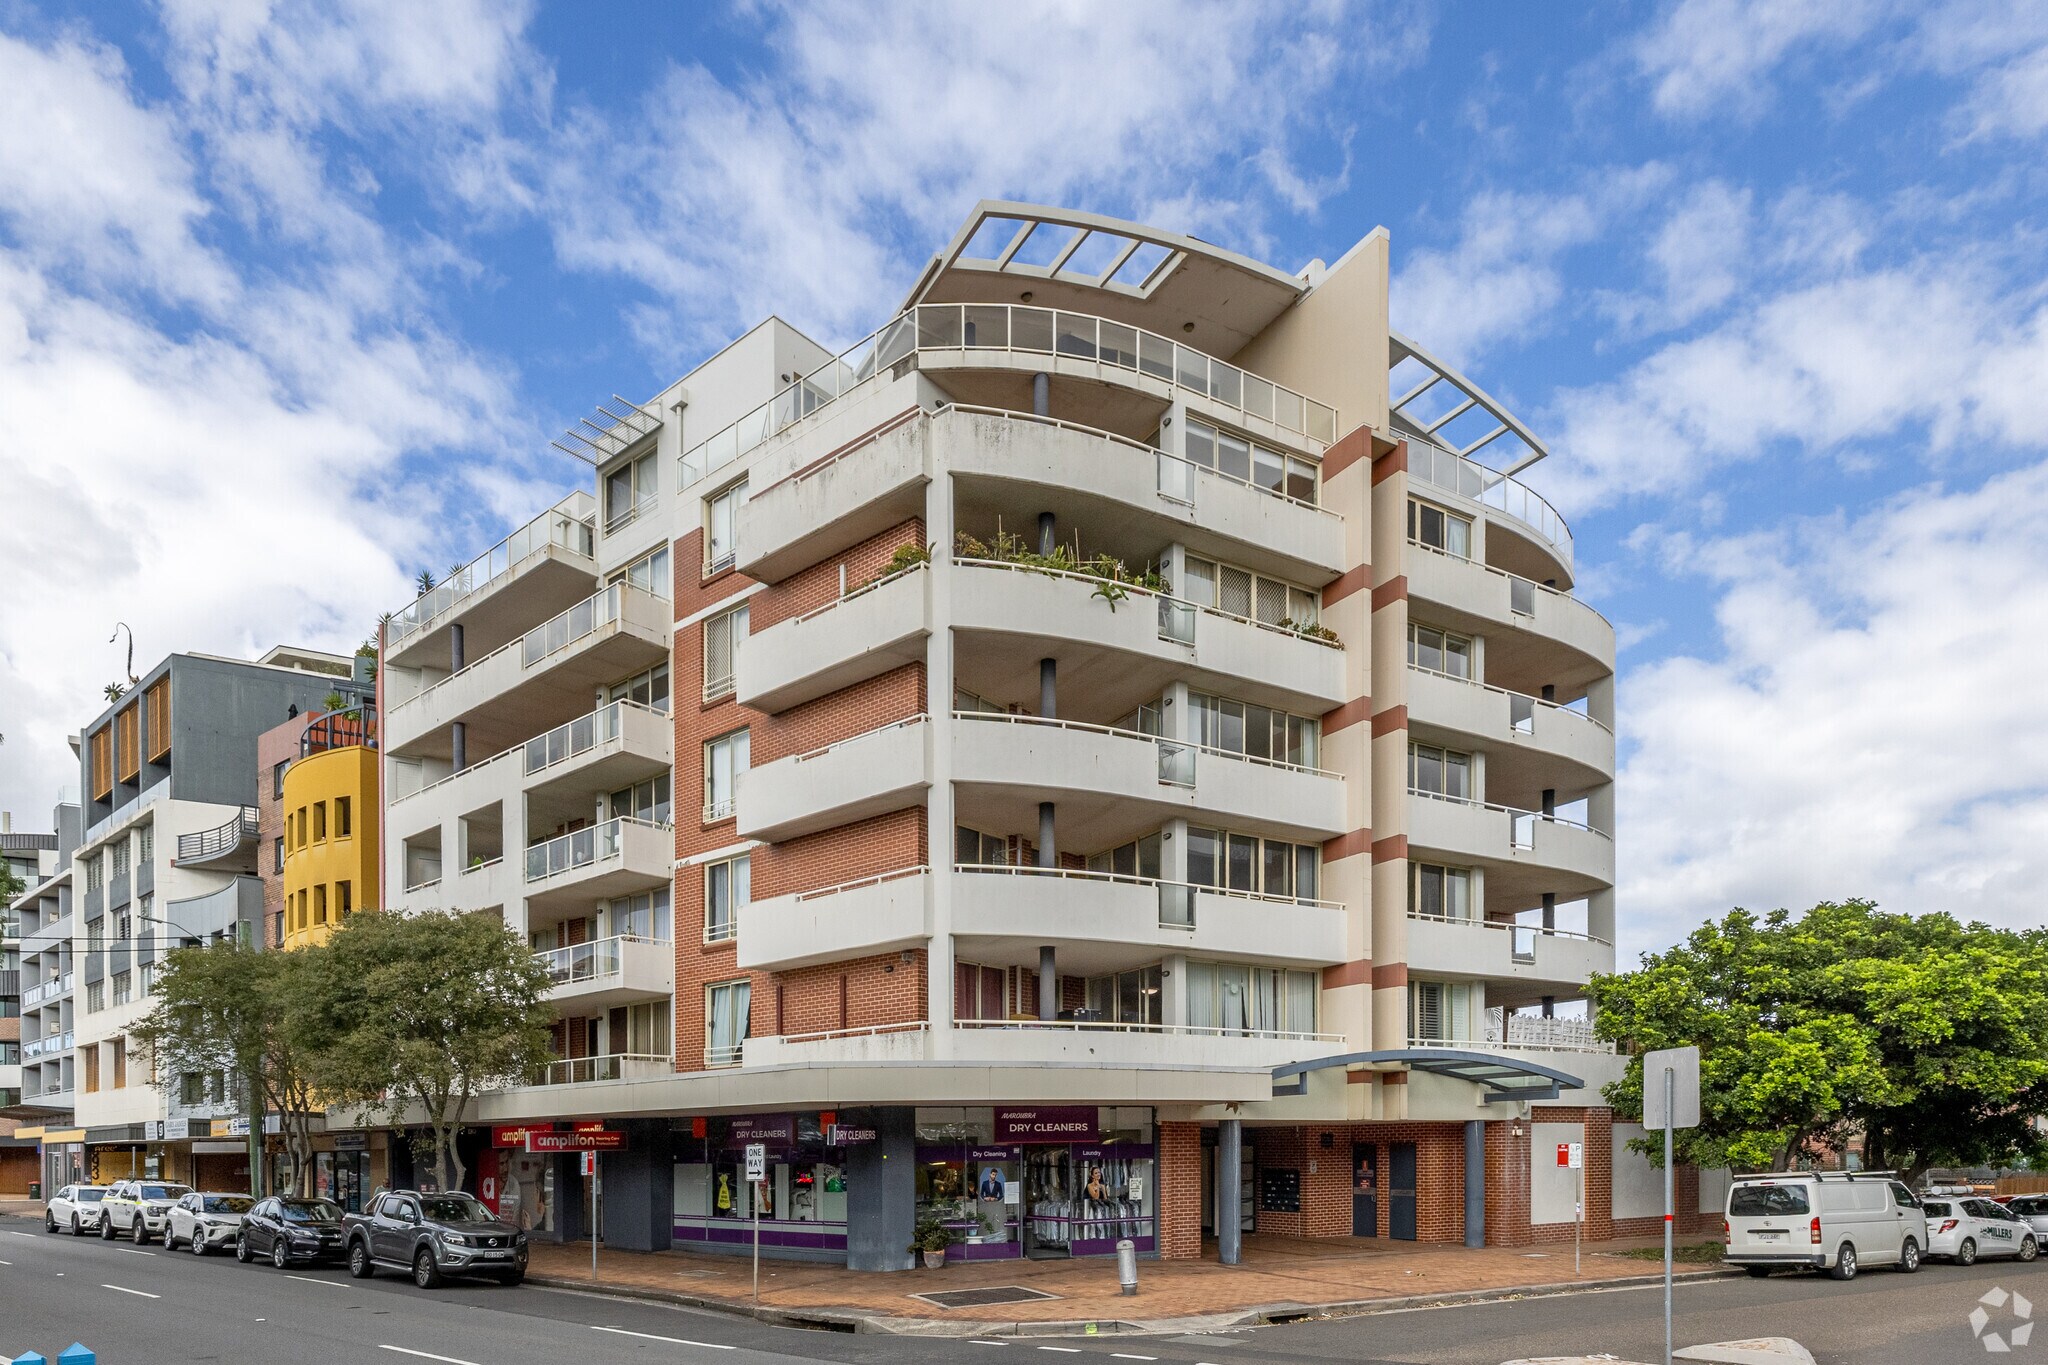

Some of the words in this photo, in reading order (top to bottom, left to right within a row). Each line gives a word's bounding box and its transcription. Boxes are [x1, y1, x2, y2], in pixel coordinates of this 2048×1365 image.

[1009, 1123, 1032, 1132] DRY
[1034, 1123, 1088, 1132] CLEANERS
[736, 1130, 750, 1139] DRY
[751, 1130, 786, 1138] CLEANERS
[836, 1130, 847, 1140] DRY
[848, 1130, 876, 1140] CLEANERS
[537, 1134, 595, 1149] amplifon
[749, 1148, 761, 1156] ONE
[748, 1159, 762, 1167] WAY
